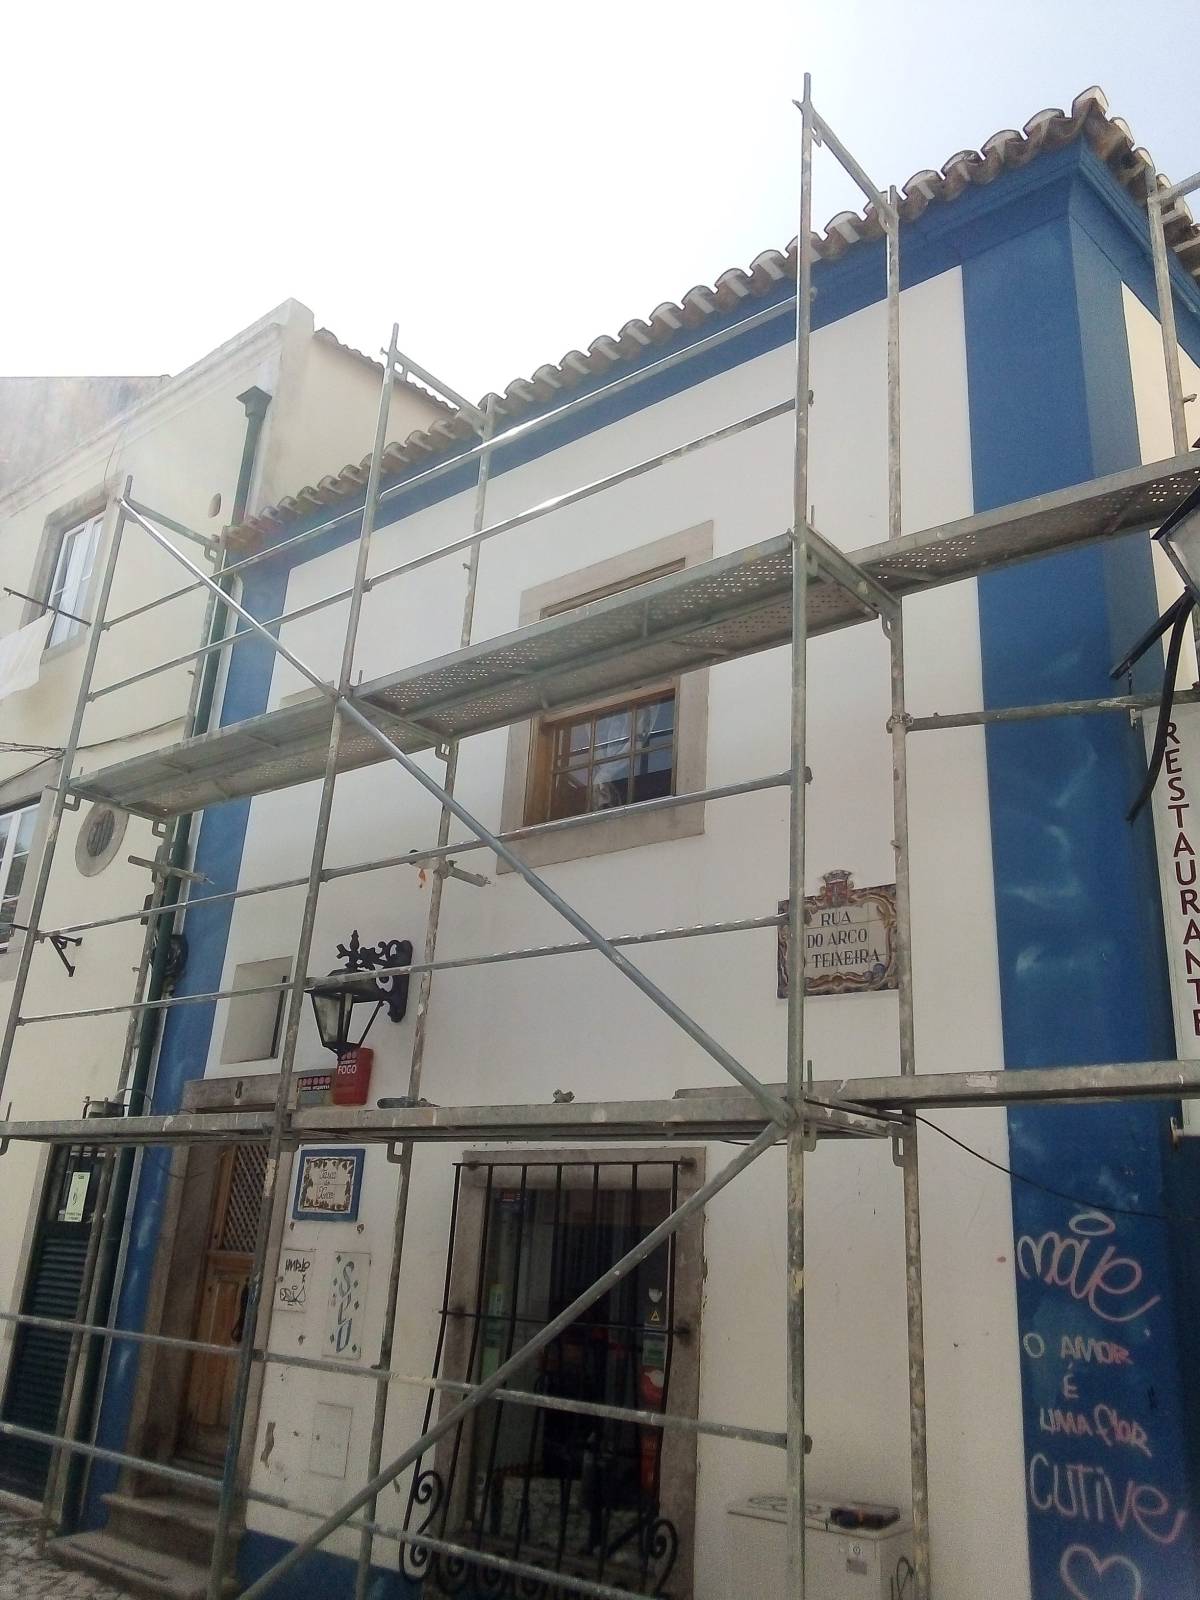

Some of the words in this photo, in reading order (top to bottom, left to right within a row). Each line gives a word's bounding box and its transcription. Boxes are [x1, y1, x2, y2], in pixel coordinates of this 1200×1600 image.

[821, 911, 852, 926] RUA
[807, 933, 823, 948] DO
[828, 928, 867, 945] ARCO
[812, 948, 880, 969] TEIXEIRA
[1060, 1335, 1134, 1364] AMOR
